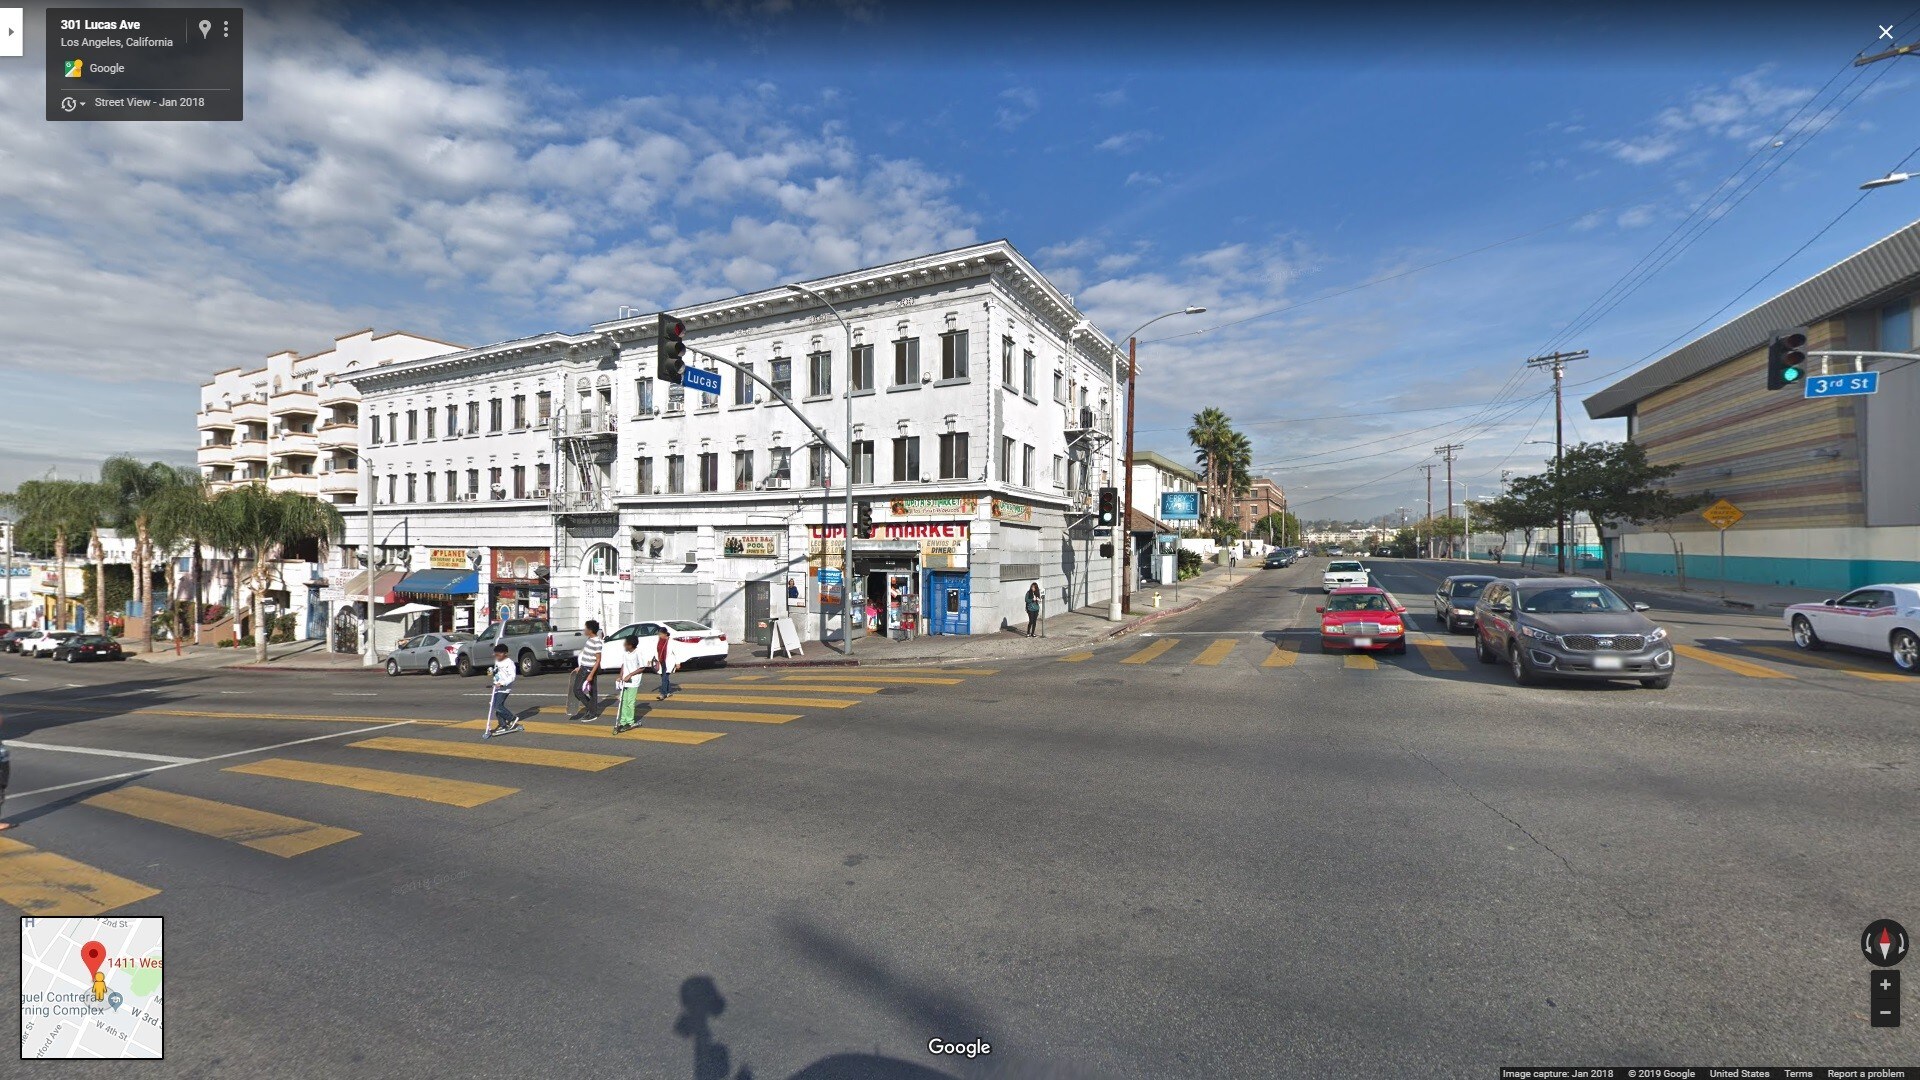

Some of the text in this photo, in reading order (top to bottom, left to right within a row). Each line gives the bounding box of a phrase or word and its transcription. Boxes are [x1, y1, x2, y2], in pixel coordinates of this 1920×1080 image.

[687, 370, 718, 389] Lucas
[1815, 377, 1869, 394] 3rd St
[812, 523, 968, 538] LUPIS MARKET
